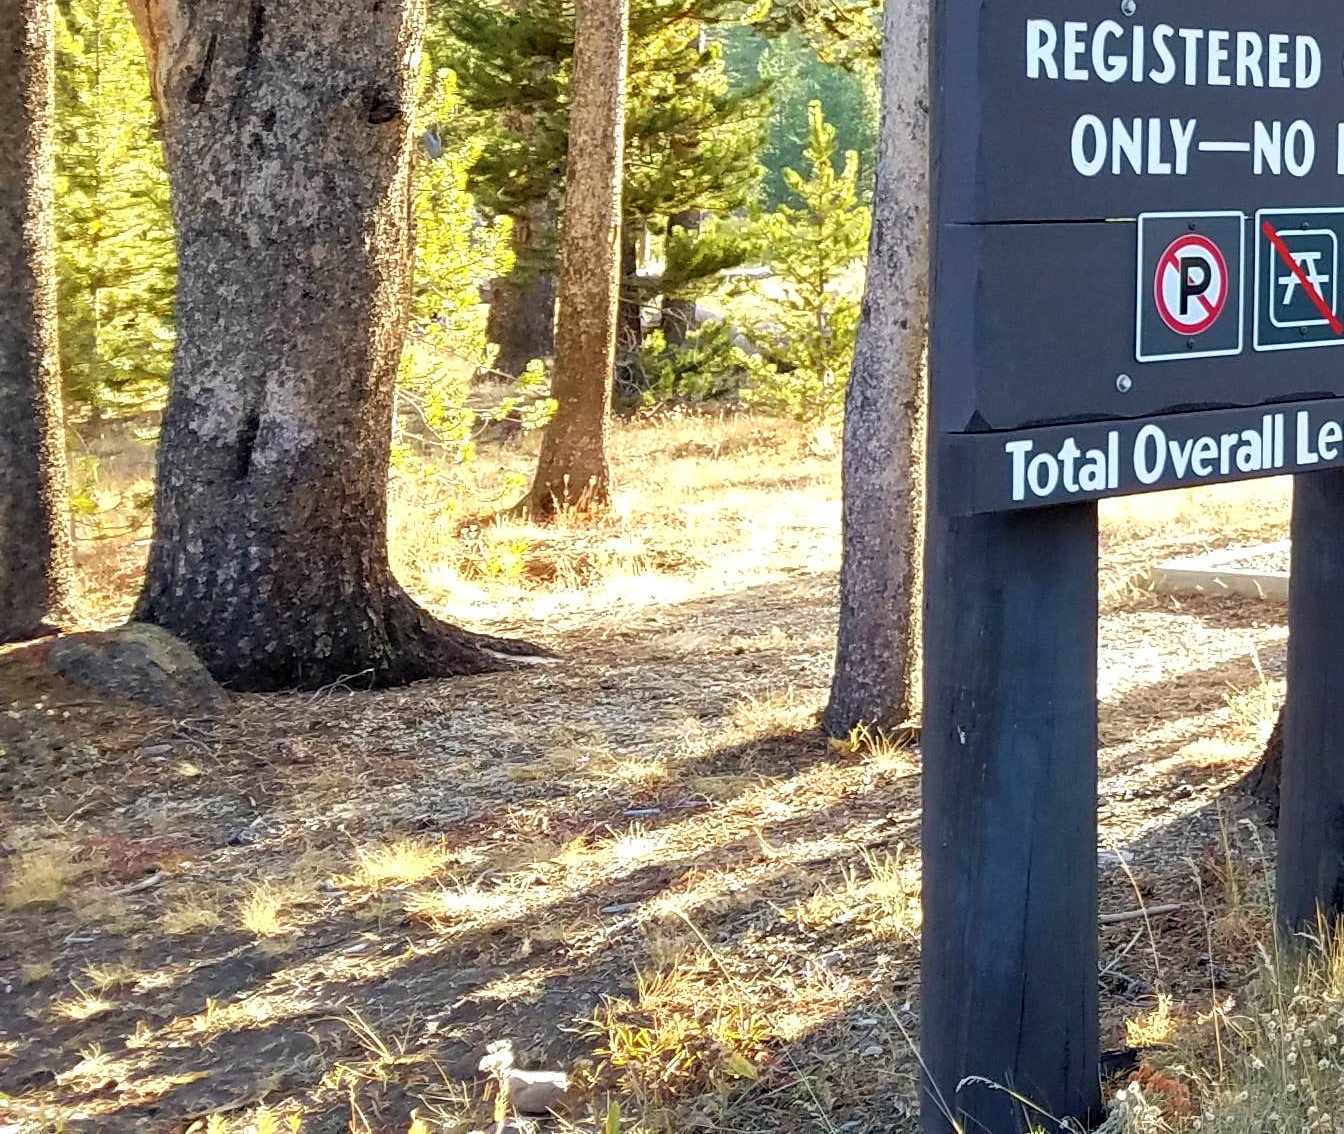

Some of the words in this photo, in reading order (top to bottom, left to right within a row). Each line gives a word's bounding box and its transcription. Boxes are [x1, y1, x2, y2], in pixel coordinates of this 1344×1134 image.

[1025, 18, 1322, 90] REGISTERED
[1005, 430, 1119, 501] Total
[1132, 412, 1284, 485] Overall
